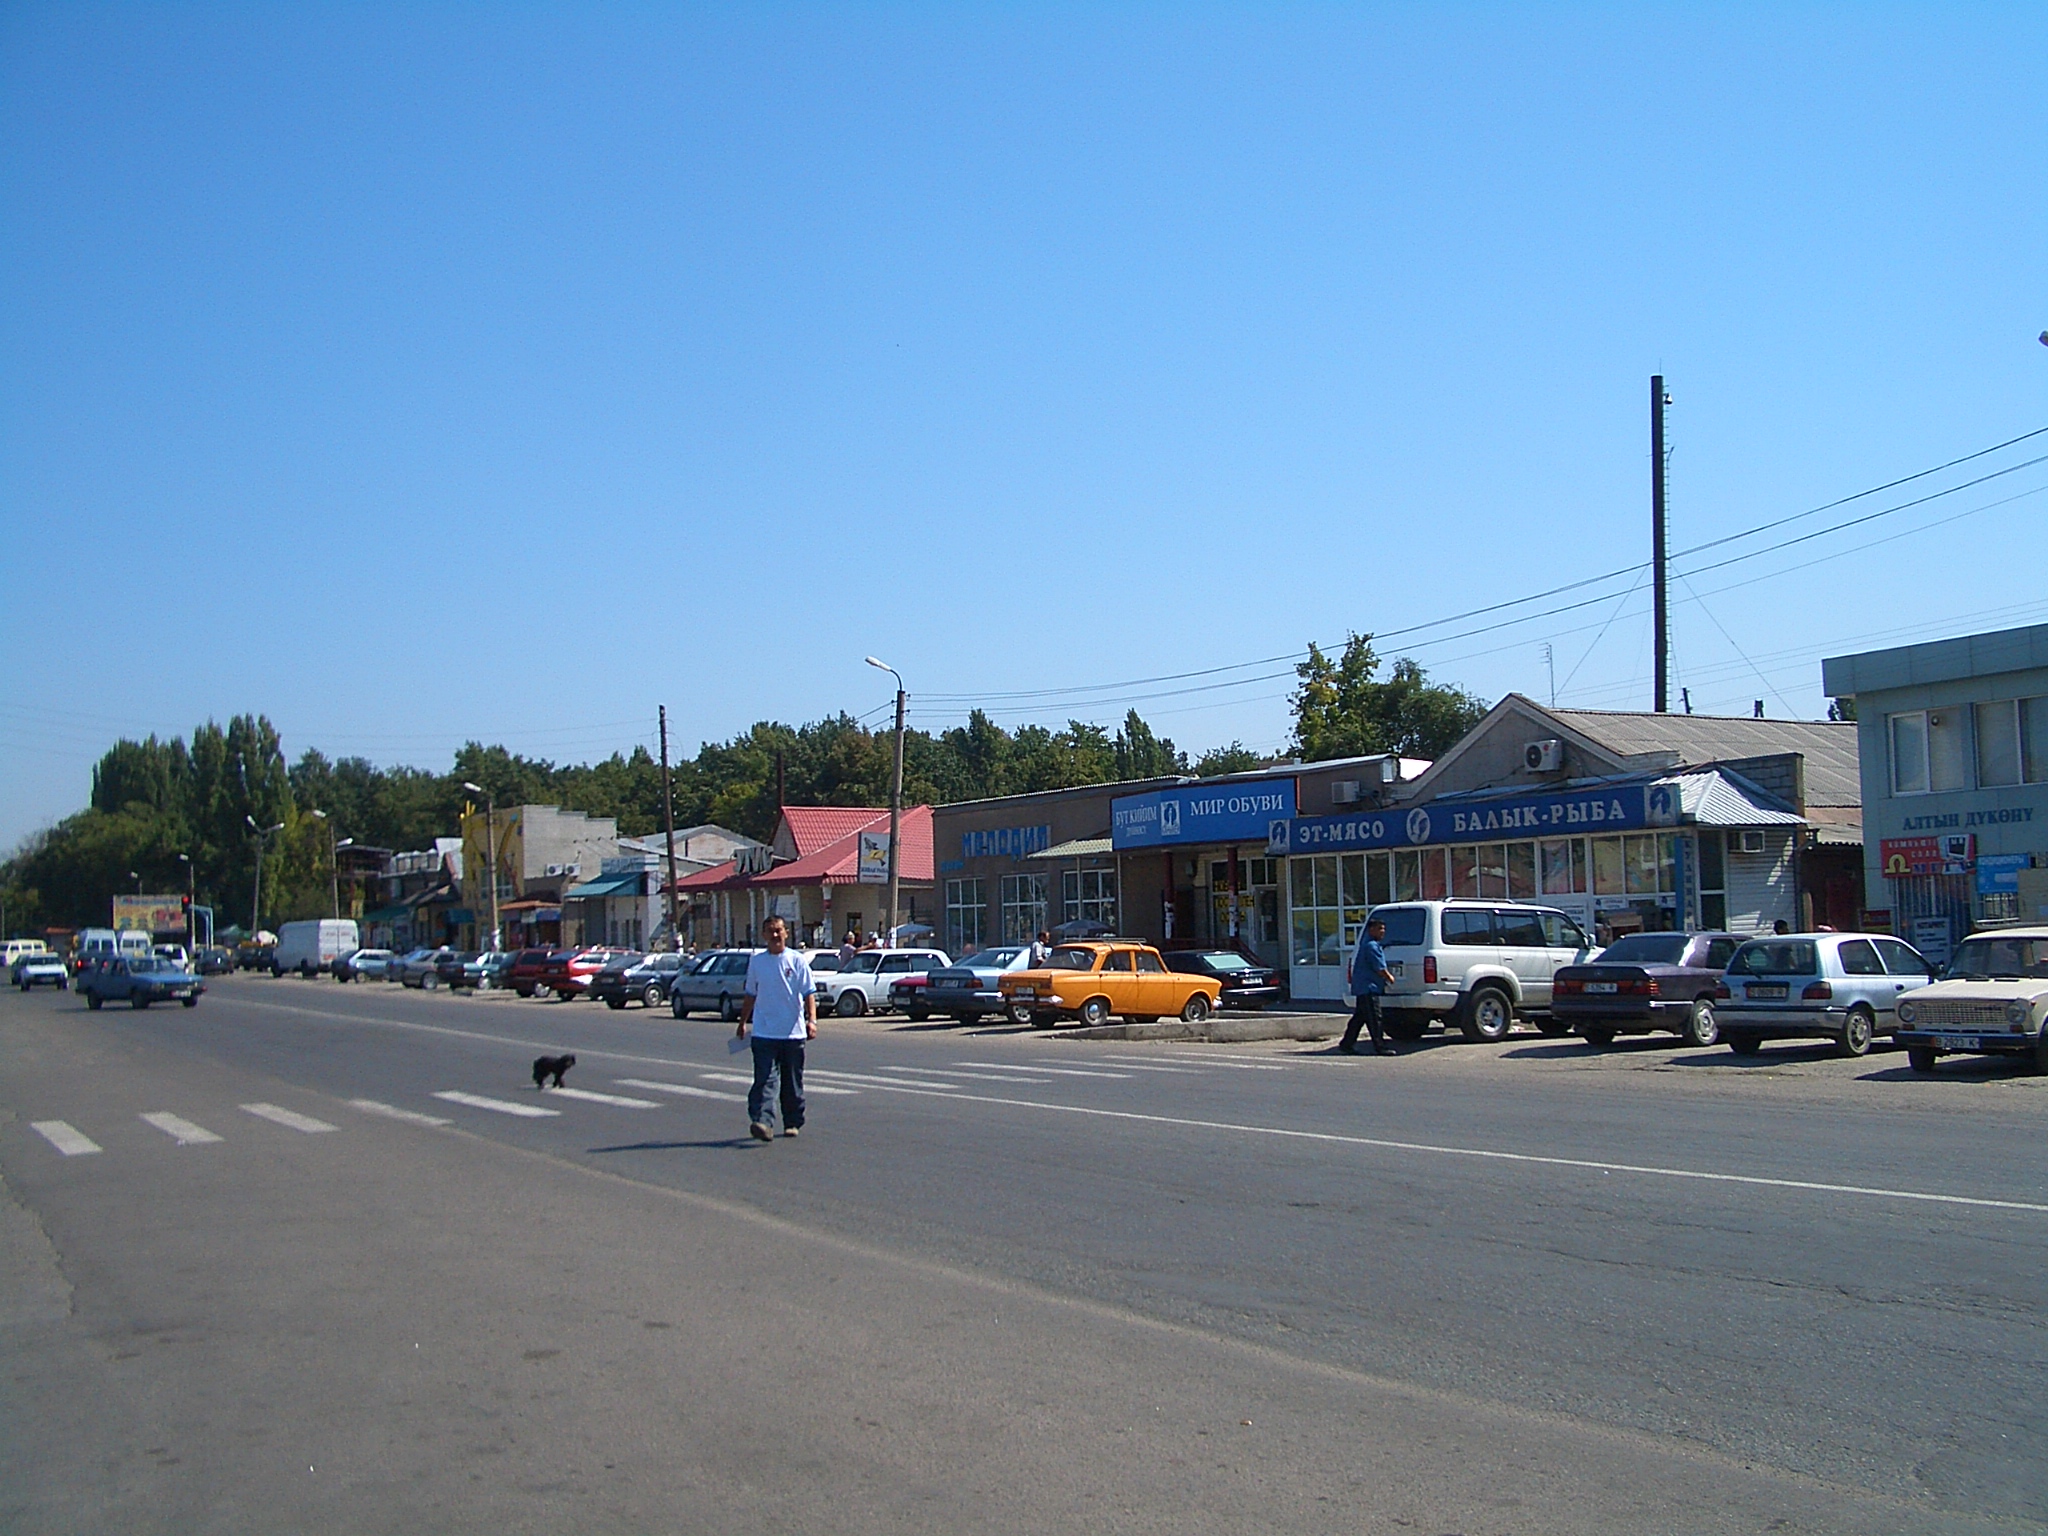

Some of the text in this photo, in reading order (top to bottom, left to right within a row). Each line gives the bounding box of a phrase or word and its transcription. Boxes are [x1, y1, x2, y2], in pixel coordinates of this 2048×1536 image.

[1190, 794, 1284, 817] МИР ОБУВИ
[1453, 799, 1626, 832] БАЛЫК-РЫБА
[1299, 820, 1385, 843] ЭТ-МЯСО
[1902, 813, 1960, 831] АЛТЫН
